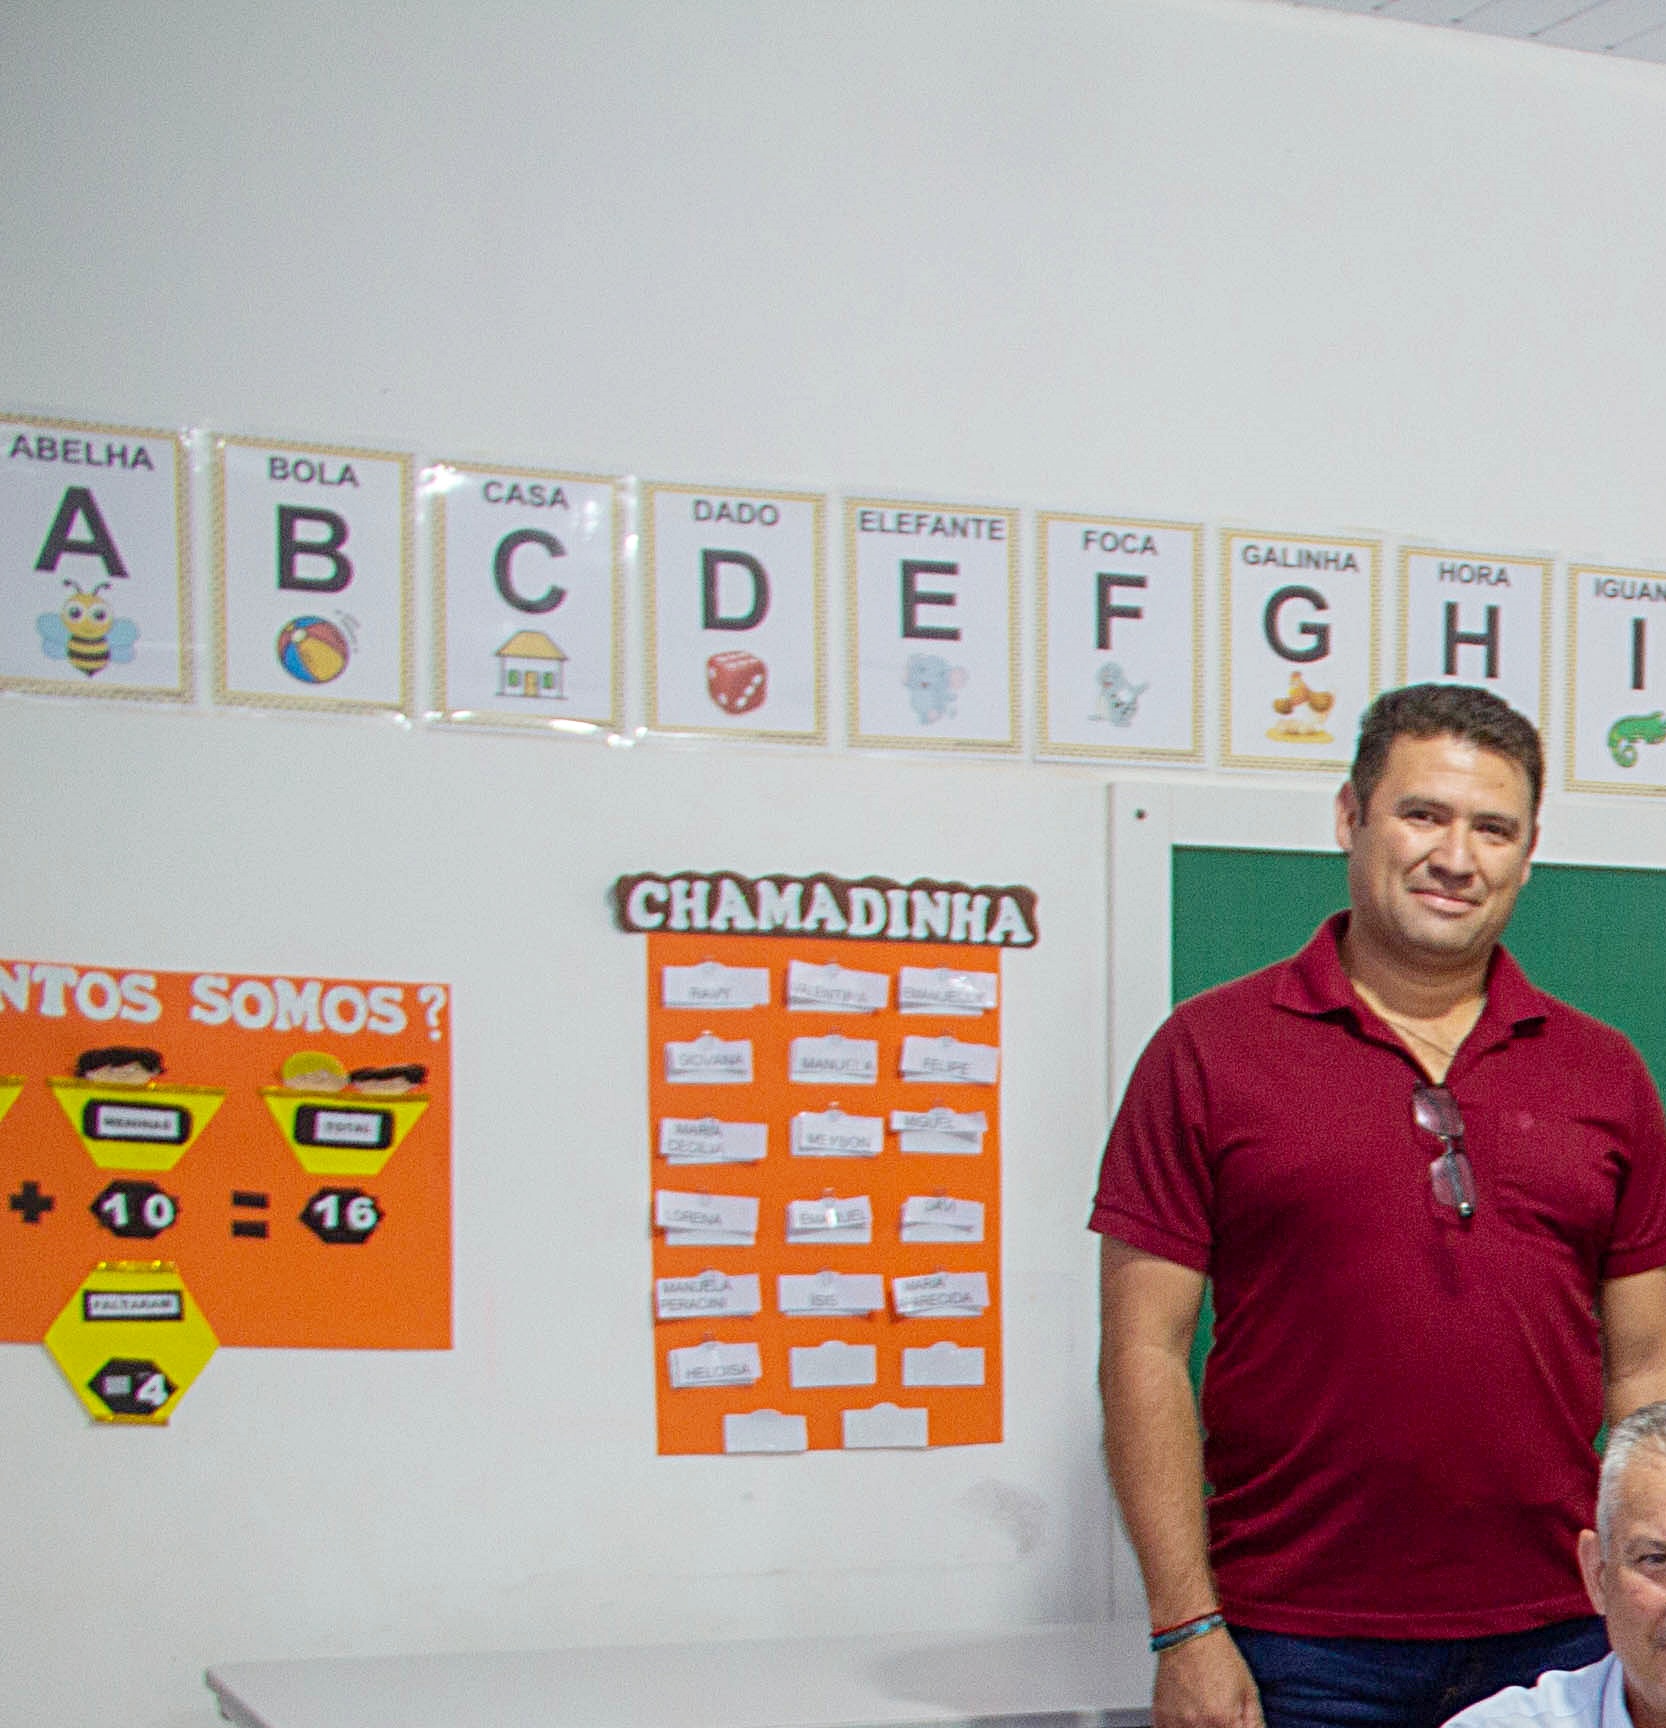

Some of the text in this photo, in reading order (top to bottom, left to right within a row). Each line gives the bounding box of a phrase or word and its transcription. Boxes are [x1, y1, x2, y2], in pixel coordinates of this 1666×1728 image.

[10, 435, 153, 470] ABELHA
[269, 457, 358, 486] BOLA
[483, 481, 568, 508] CASA
[694, 499, 779, 526] DADO
[860, 510, 1003, 540] ELEFANTE
[35, 487, 128, 578] A
[278, 505, 352, 593] B
[1083, 530, 1157, 554] FOCA
[1243, 545, 1358, 571] GALINHA
[493, 529, 566, 614] C
[702, 549, 769, 631] D
[901, 560, 960, 641] E
[1439, 564, 1509, 586] HORA
[1097, 573, 1146, 650] F
[1264, 586, 1329, 663] G
[1444, 602, 1498, 679] H
[1632, 619, 1644, 690] I
[626, 878, 1033, 944] CHAMADINHA
[102, 1192, 178, 1227] 10
[312, 1195, 379, 1230] 16
